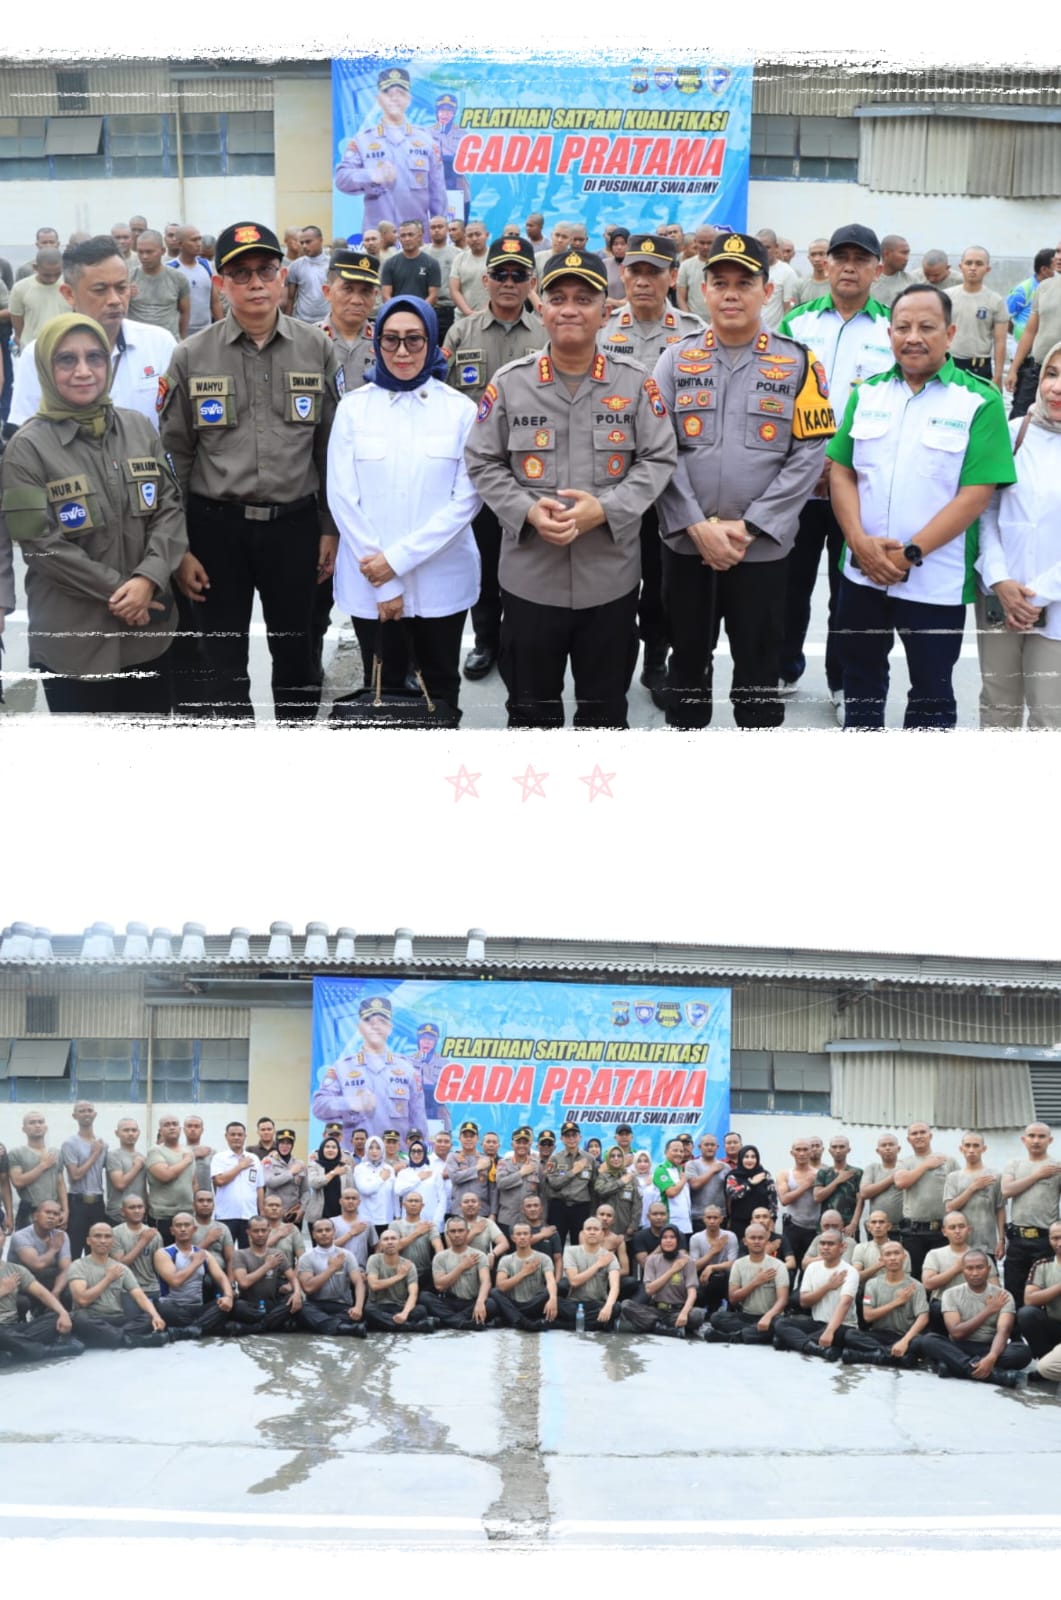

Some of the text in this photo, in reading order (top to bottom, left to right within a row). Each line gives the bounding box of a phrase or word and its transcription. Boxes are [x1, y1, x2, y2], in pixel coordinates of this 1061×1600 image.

[460, 108, 729, 132] PELATIHAN SATPAM KUALIFIKASI
[453, 134, 727, 177] GADA PRATAMA
[584, 180, 719, 194] DI PUSDIKLAT SWA ARMY
[196, 382, 223, 392] WAHYU
[756, 381, 791, 395] POLRI
[513, 416, 548, 427] ASEP
[51, 481, 82, 498] NUR A
[441, 1036, 709, 1063] PELATIHAN SATPAM KUALIFIKASI
[434, 1064, 707, 1108] GADA PRATAMA
[566, 1110, 701, 1125] DI PUSDIKLAT SWA ARMY
